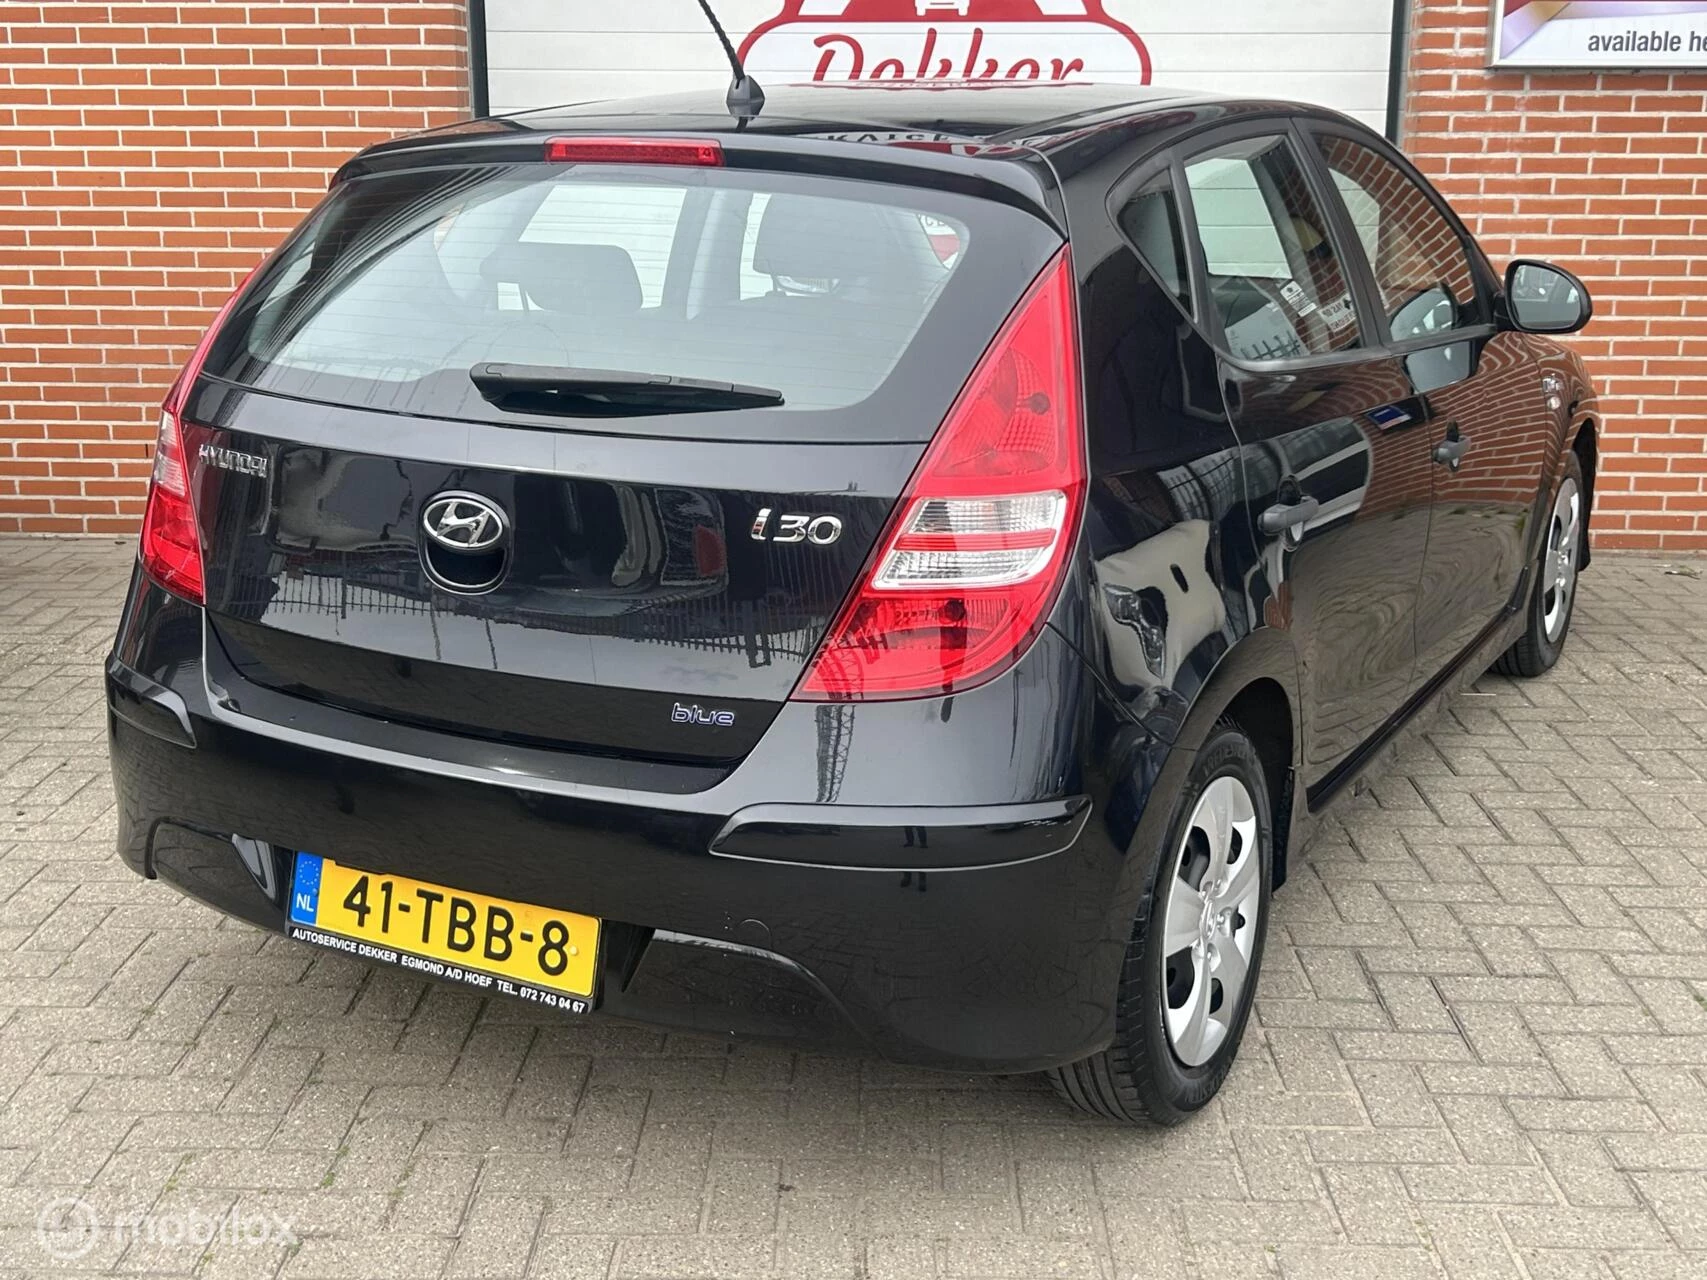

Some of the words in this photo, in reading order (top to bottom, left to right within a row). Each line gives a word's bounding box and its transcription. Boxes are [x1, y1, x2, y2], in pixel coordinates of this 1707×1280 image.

[1587, 30, 1682, 52] available
[198, 443, 268, 478] HYUNDAI
[671, 702, 735, 727] blue
[295, 892, 315, 913] NL
[342, 874, 571, 977] 41-TBB-8
[292, 928, 357, 953] AUTOSERVICE
[358, 943, 398, 964] DEKKER
[401, 954, 444, 975] EGMOND
[445, 966, 463, 980] A/D
[464, 971, 493, 988] HOEF
[497, 980, 518, 996] TEL.
[520, 986, 538, 1001] 072
[539, 991, 557, 1007] 743
[558, 996, 571, 1010] 04
[572, 1001, 586, 1014] 67
